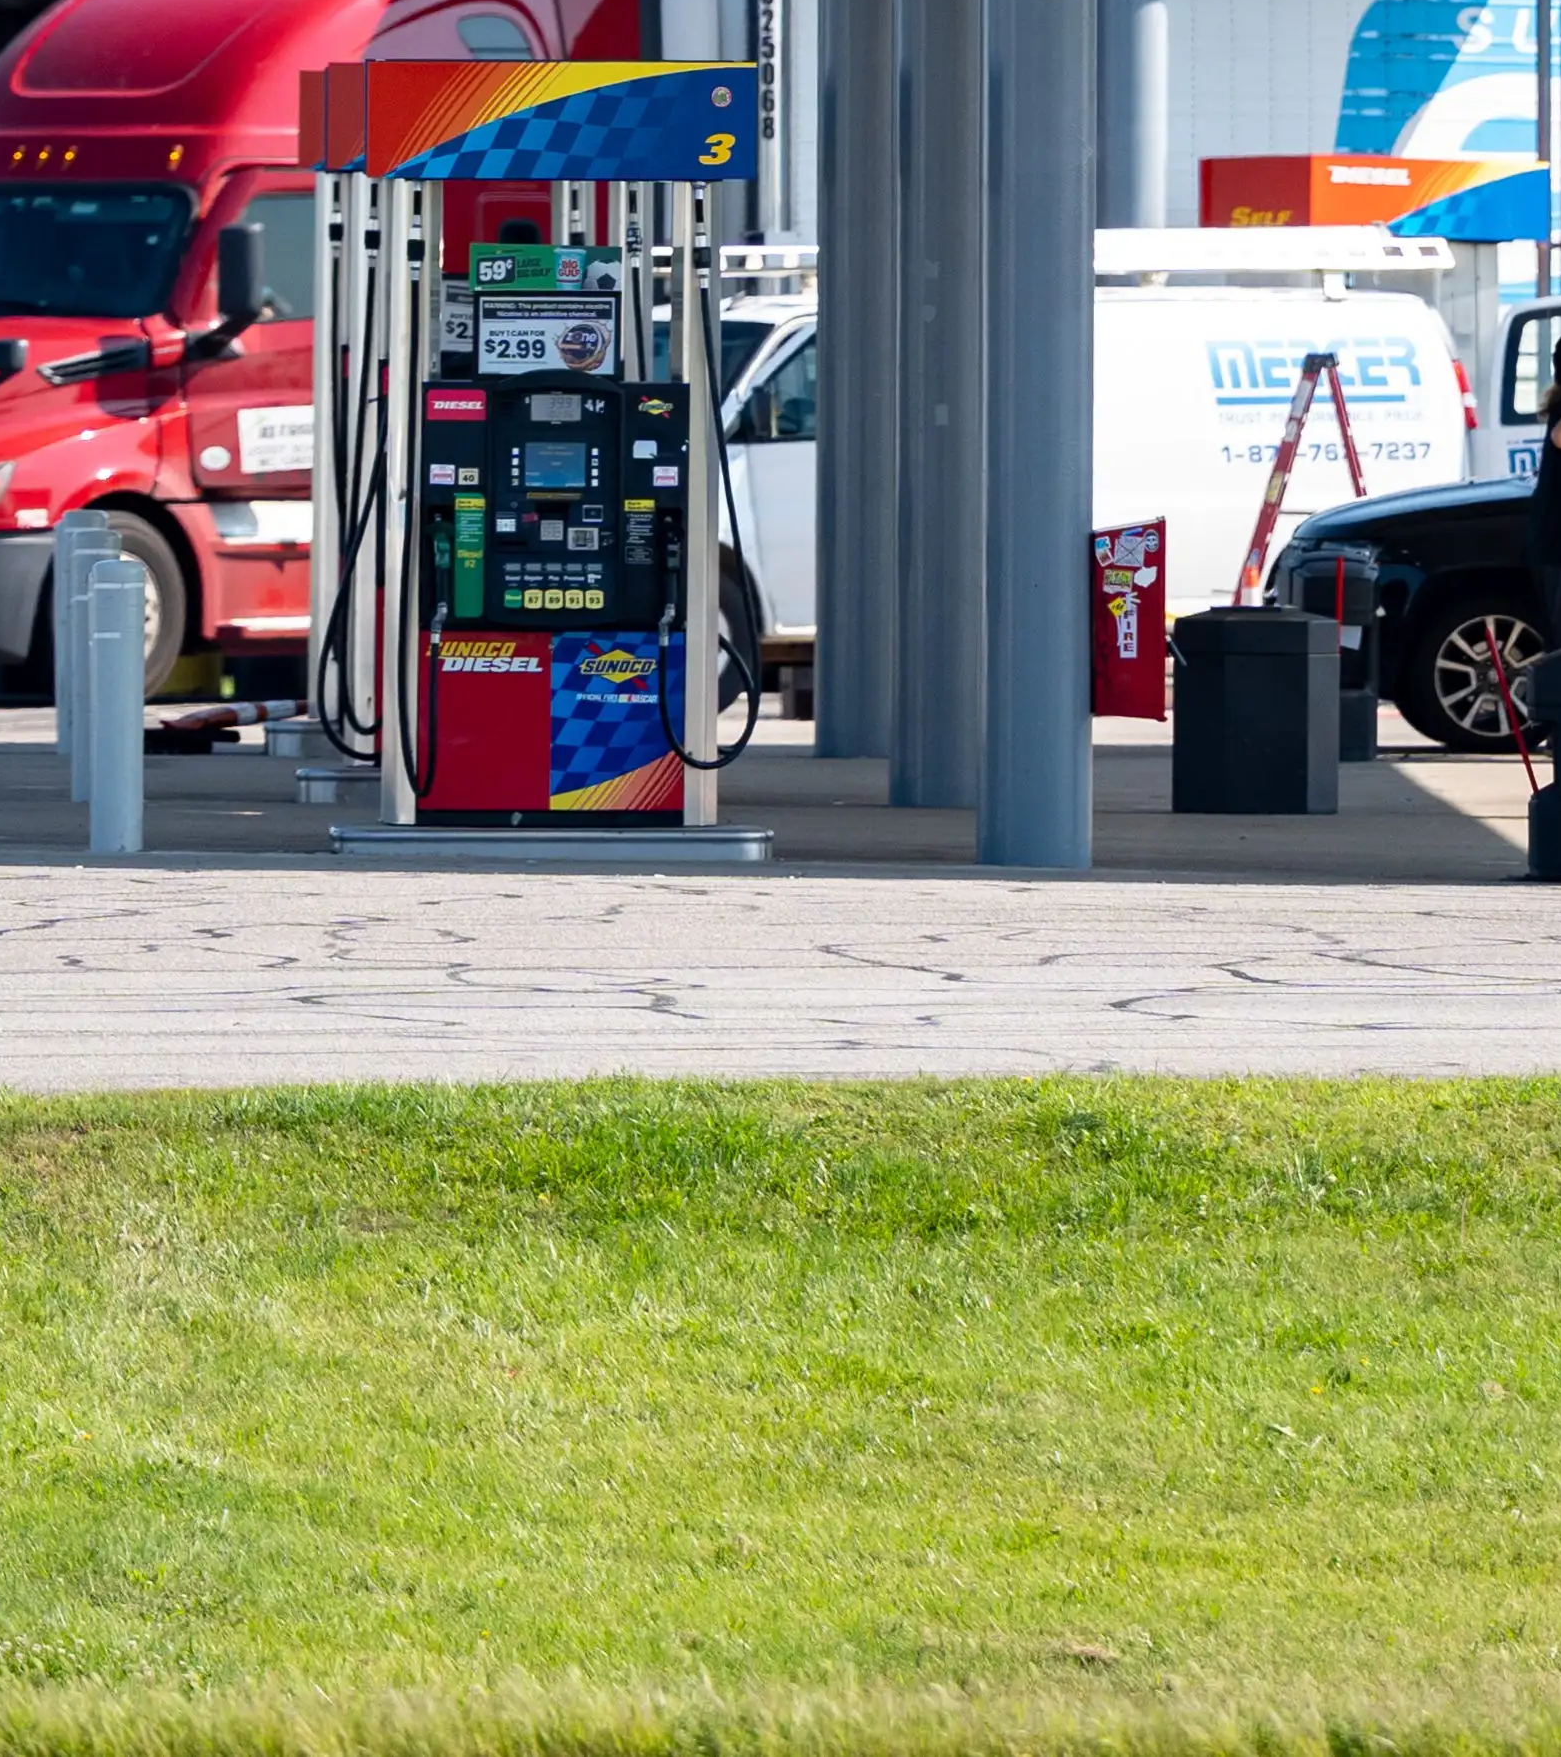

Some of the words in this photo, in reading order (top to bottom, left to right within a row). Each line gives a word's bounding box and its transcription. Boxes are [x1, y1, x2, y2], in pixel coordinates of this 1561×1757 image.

[699, 132, 737, 166] 3
[484, 339, 546, 359] $2.99
[432, 400, 485, 410] DIESEL
[1221, 442, 1431, 463] 1-87-76-7237
[439, 657, 543, 672] DIESEL
[584, 659, 654, 673] SUNOCO
